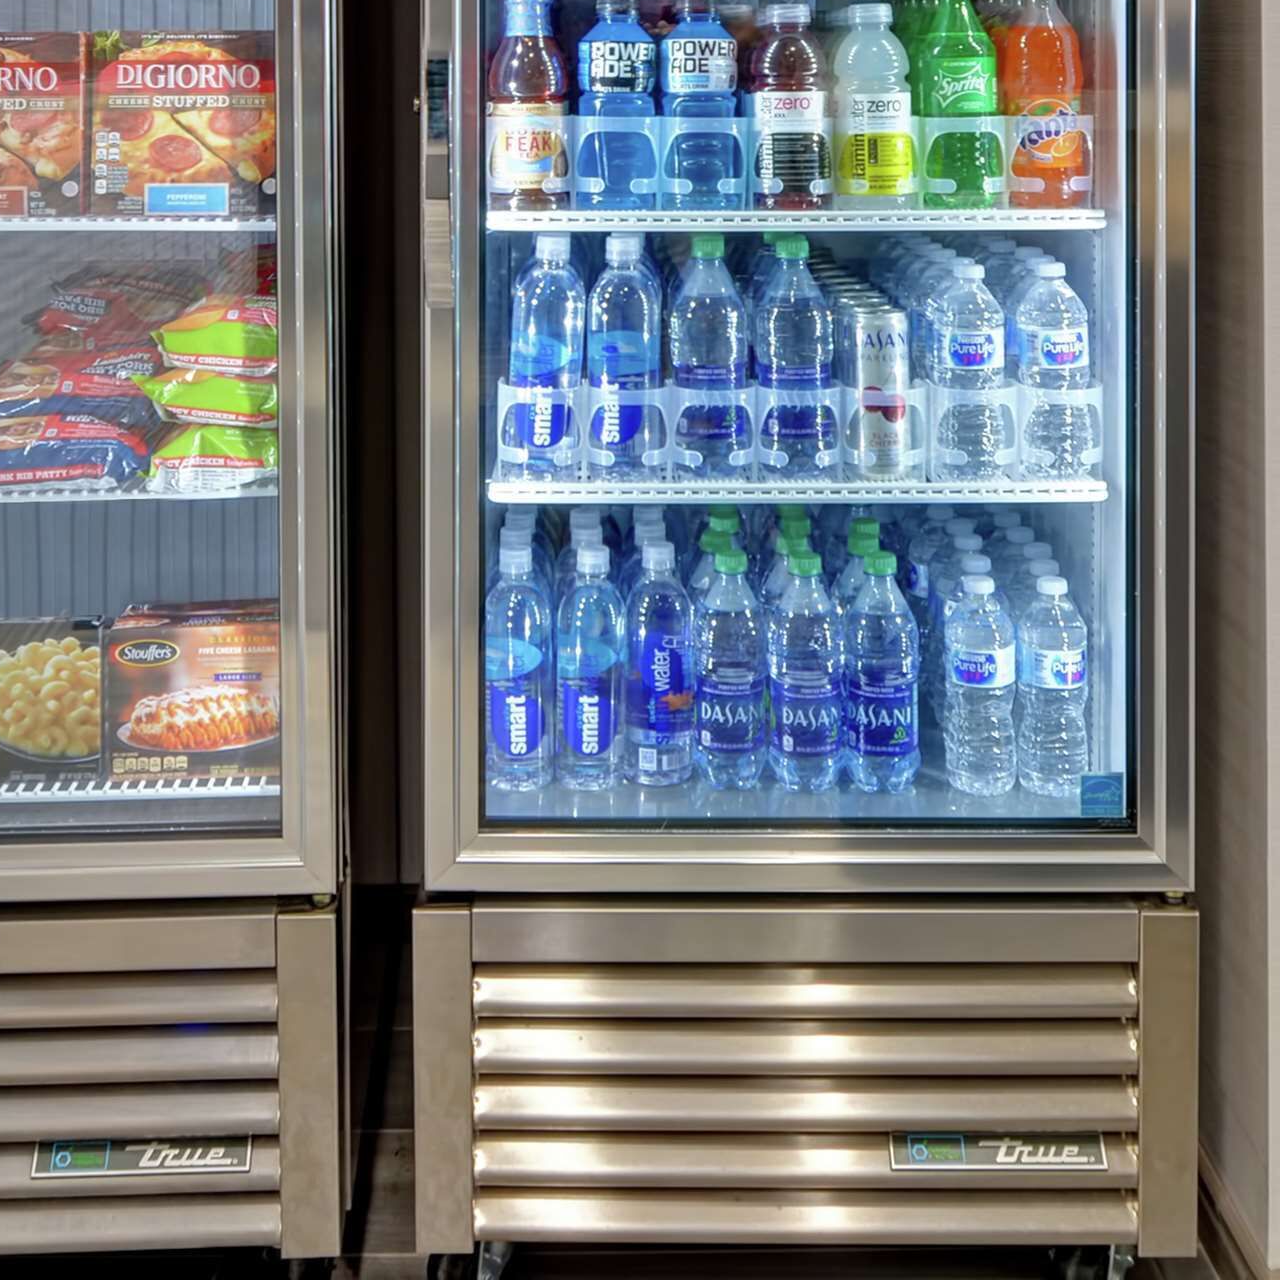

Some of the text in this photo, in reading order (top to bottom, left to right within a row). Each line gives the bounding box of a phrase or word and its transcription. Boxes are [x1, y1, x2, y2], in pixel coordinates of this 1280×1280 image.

[590, 42, 655, 61] POWER
[671, 40, 736, 57] POWER
[671, 58, 709, 74] ADE
[116, 64, 261, 90] DIGIORNO
[938, 76, 986, 96] Sprite
[29, 100, 65, 109] CRUST
[109, 95, 267, 108] CHEESE STUFFED CRUST
[773, 95, 811, 110] zero
[866, 99, 902, 113] zero
[950, 343, 976, 354] Pure
[532, 385, 553, 447] smart
[603, 383, 621, 444] smart
[35, 469, 68, 480] PATTY
[122, 644, 172, 662] Stouffer's
[651, 649, 671, 692] water
[953, 660, 977, 671] Pure
[847, 703, 912, 729] DASANI
[505, 695, 528, 756] smart
[577, 695, 600, 756] smart
